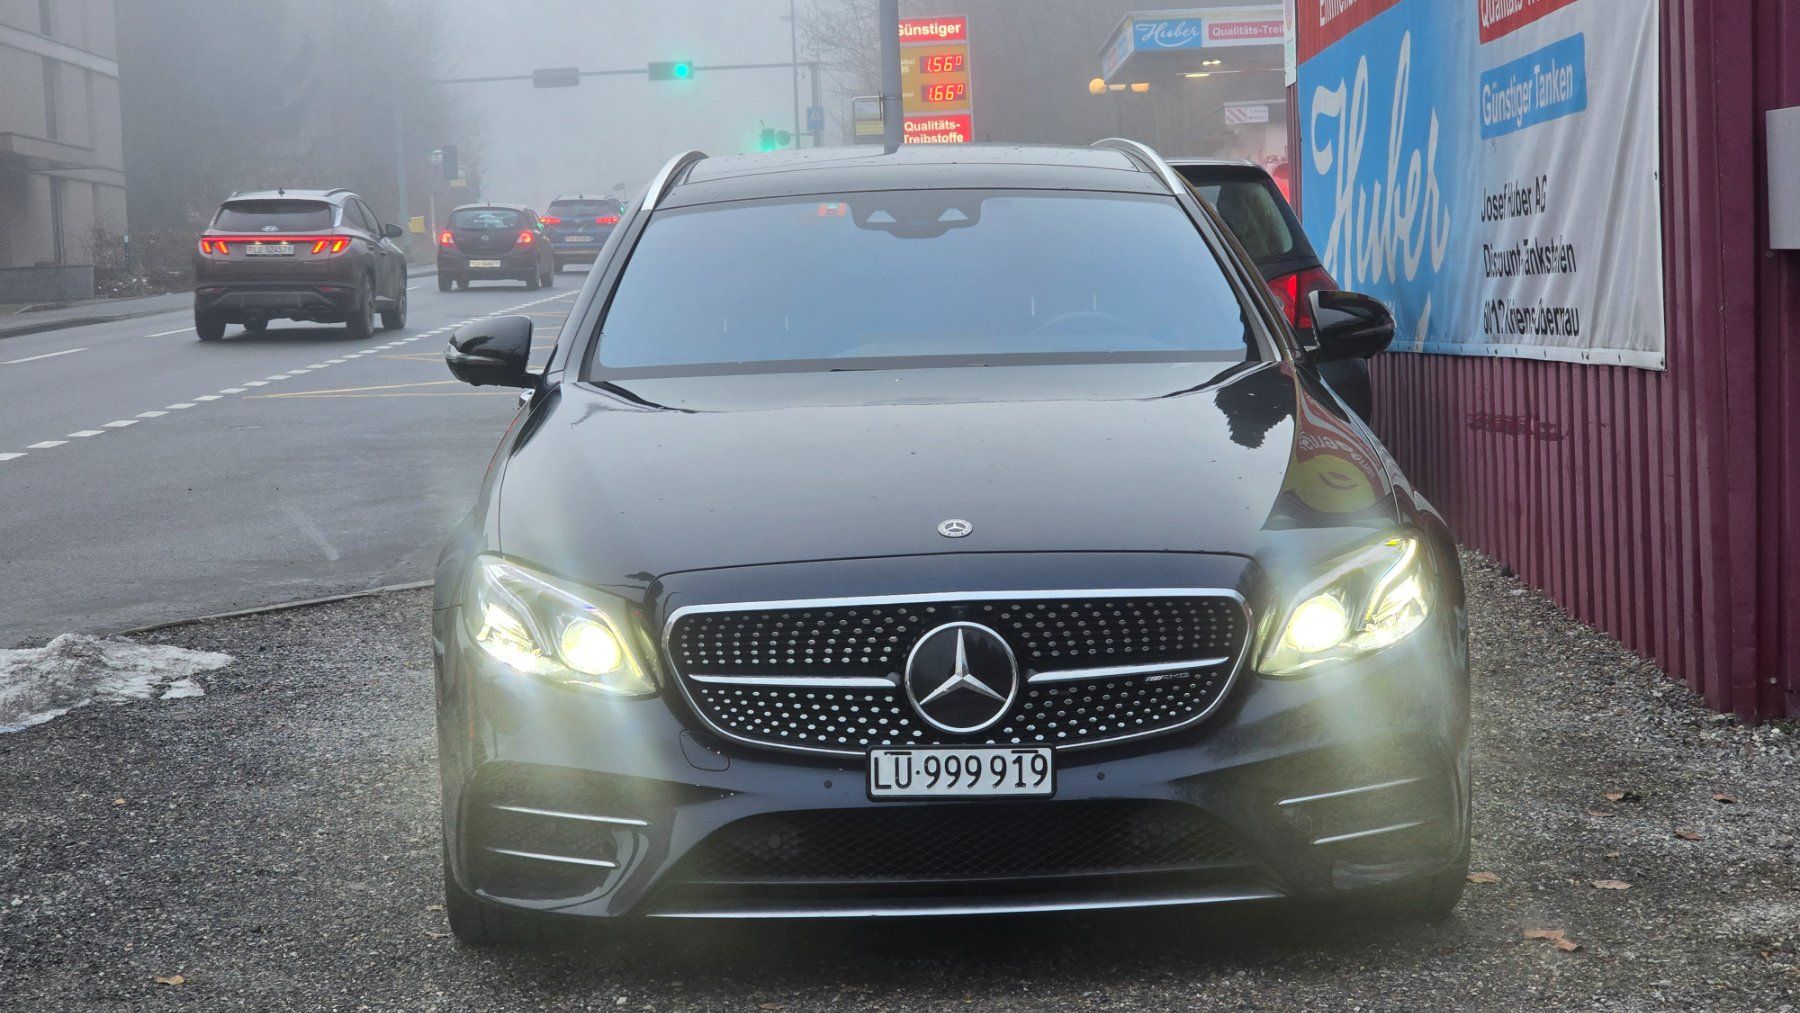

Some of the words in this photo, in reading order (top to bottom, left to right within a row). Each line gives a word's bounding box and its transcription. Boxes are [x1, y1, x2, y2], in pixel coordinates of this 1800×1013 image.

[1136, 21, 1200, 47] Huber
[1482, 74, 1533, 127] Günstiger
[1534, 58, 1573, 109] Tanken
[904, 120, 961, 132] Qualitäts-
[1311, 30, 1451, 291] Huber
[1535, 174, 1548, 214] AG
